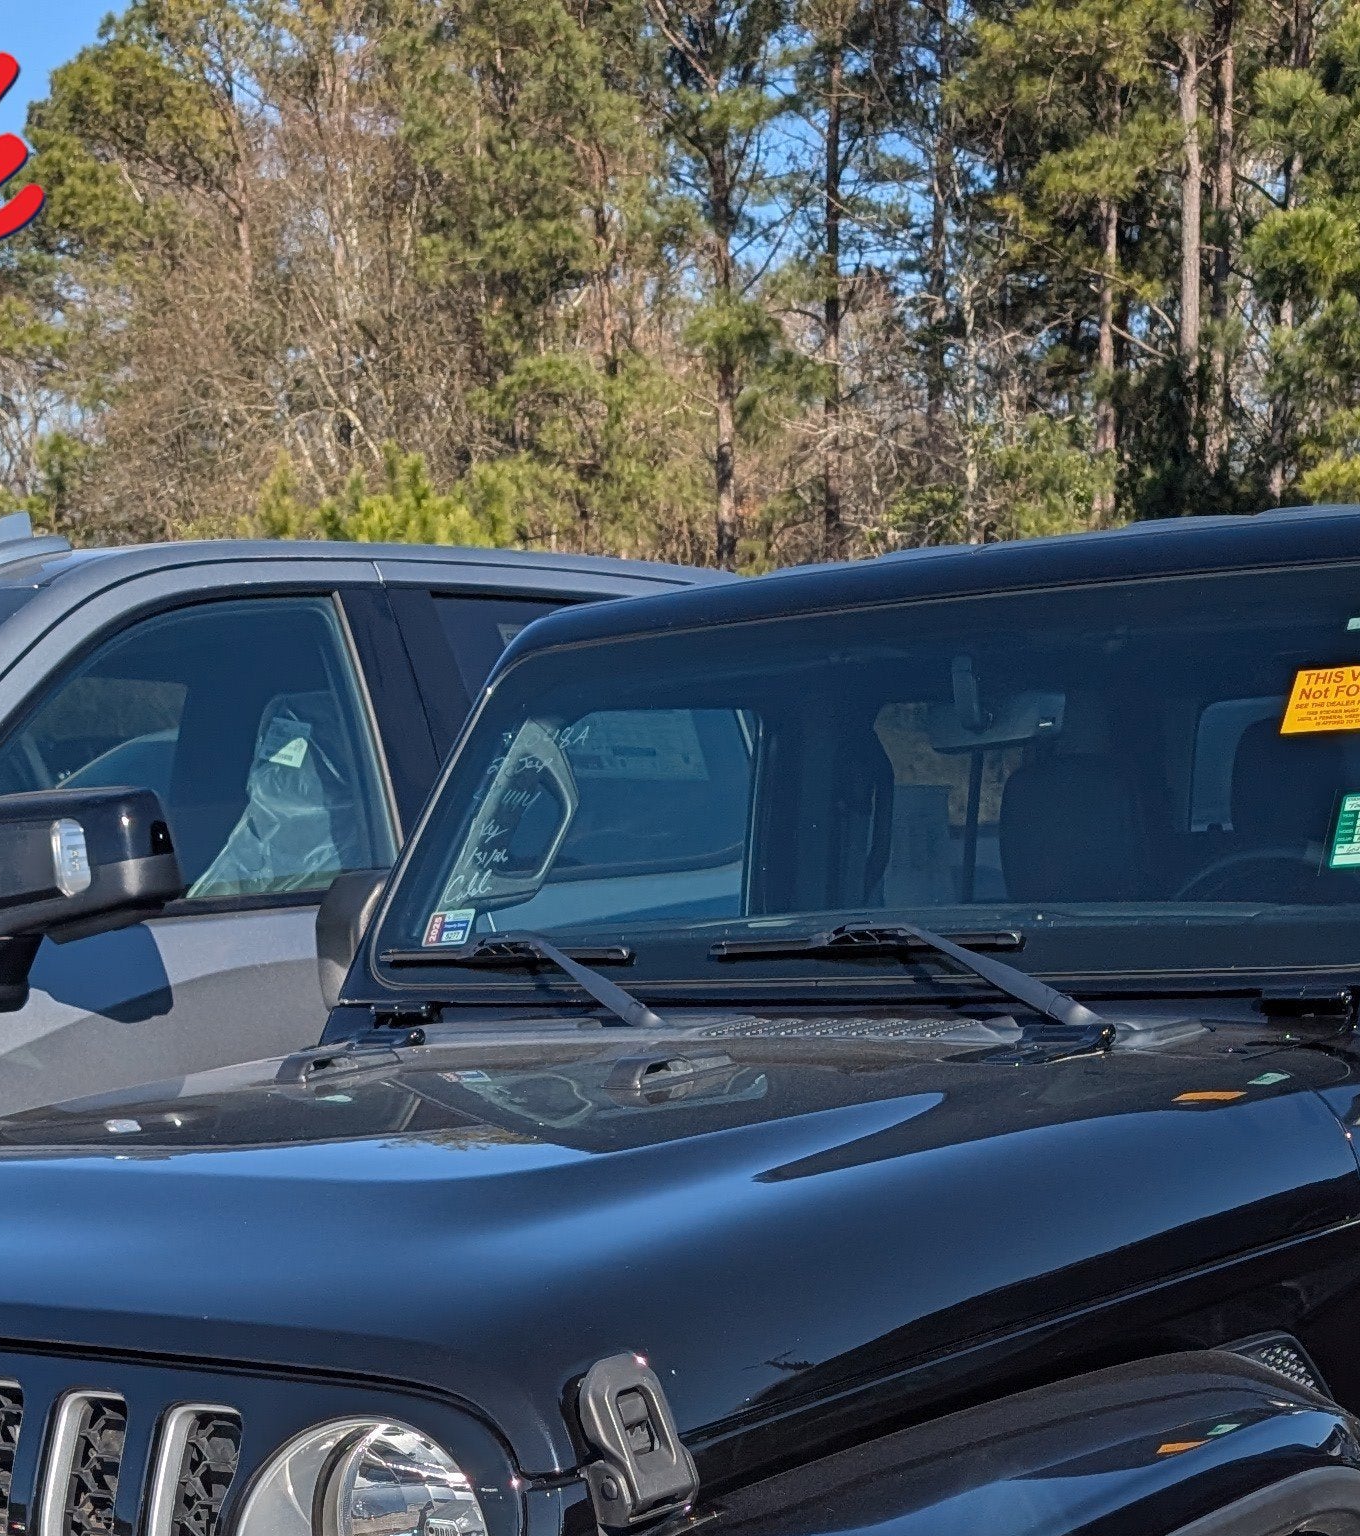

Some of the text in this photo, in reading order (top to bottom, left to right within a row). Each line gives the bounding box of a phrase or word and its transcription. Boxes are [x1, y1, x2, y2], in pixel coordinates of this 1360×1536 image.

[1305, 671, 1345, 686] THIS
[1298, 686, 1329, 700] Not
[1326, 700, 1355, 708] DEALER
